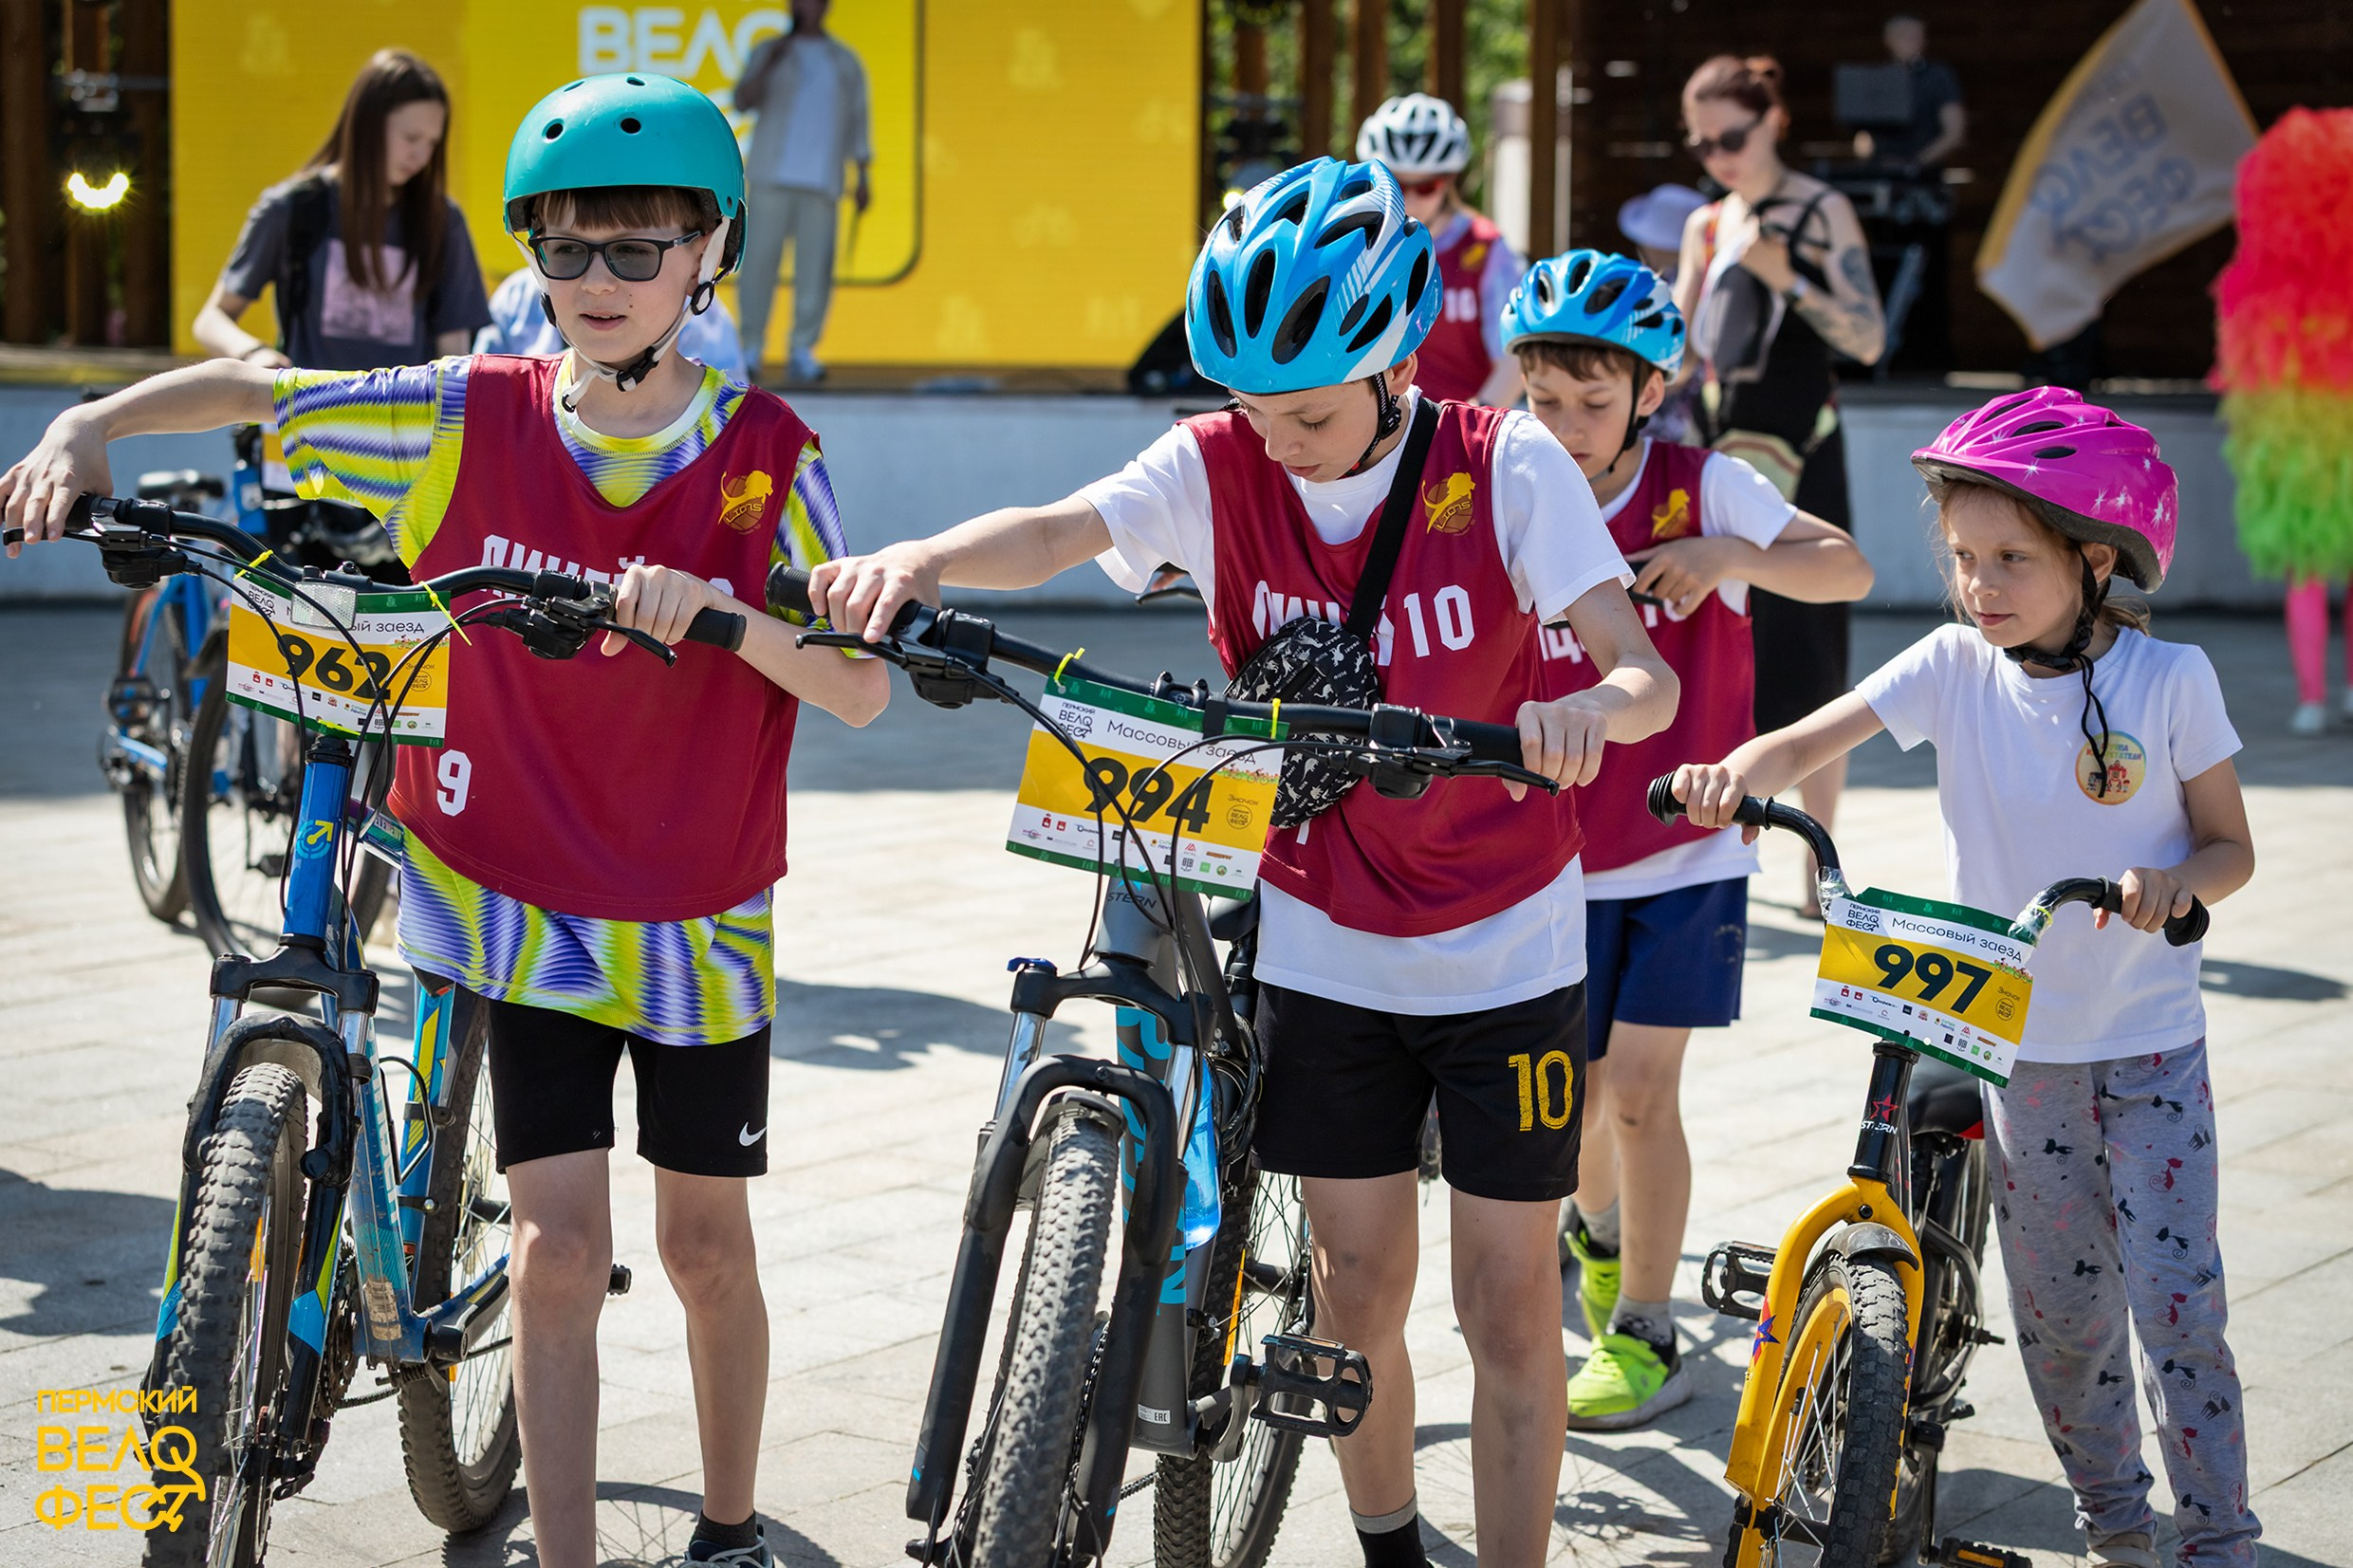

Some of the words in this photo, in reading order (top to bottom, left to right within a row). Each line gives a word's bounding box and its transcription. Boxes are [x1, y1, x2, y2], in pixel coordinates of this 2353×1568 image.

[376, 620, 425, 634] заезд
[1403, 584, 1474, 657] 10
[277, 634, 391, 700] 962
[436, 748, 472, 817] 9
[1084, 756, 1214, 835] 994
[1107, 892, 1157, 909] STERN
[1892, 917, 1975, 945] Массовый
[1979, 938, 2022, 963] заезд
[1874, 944, 1992, 1014] 997
[1508, 1050, 1573, 1131] 10
[1861, 1120, 1898, 1134] STERN
